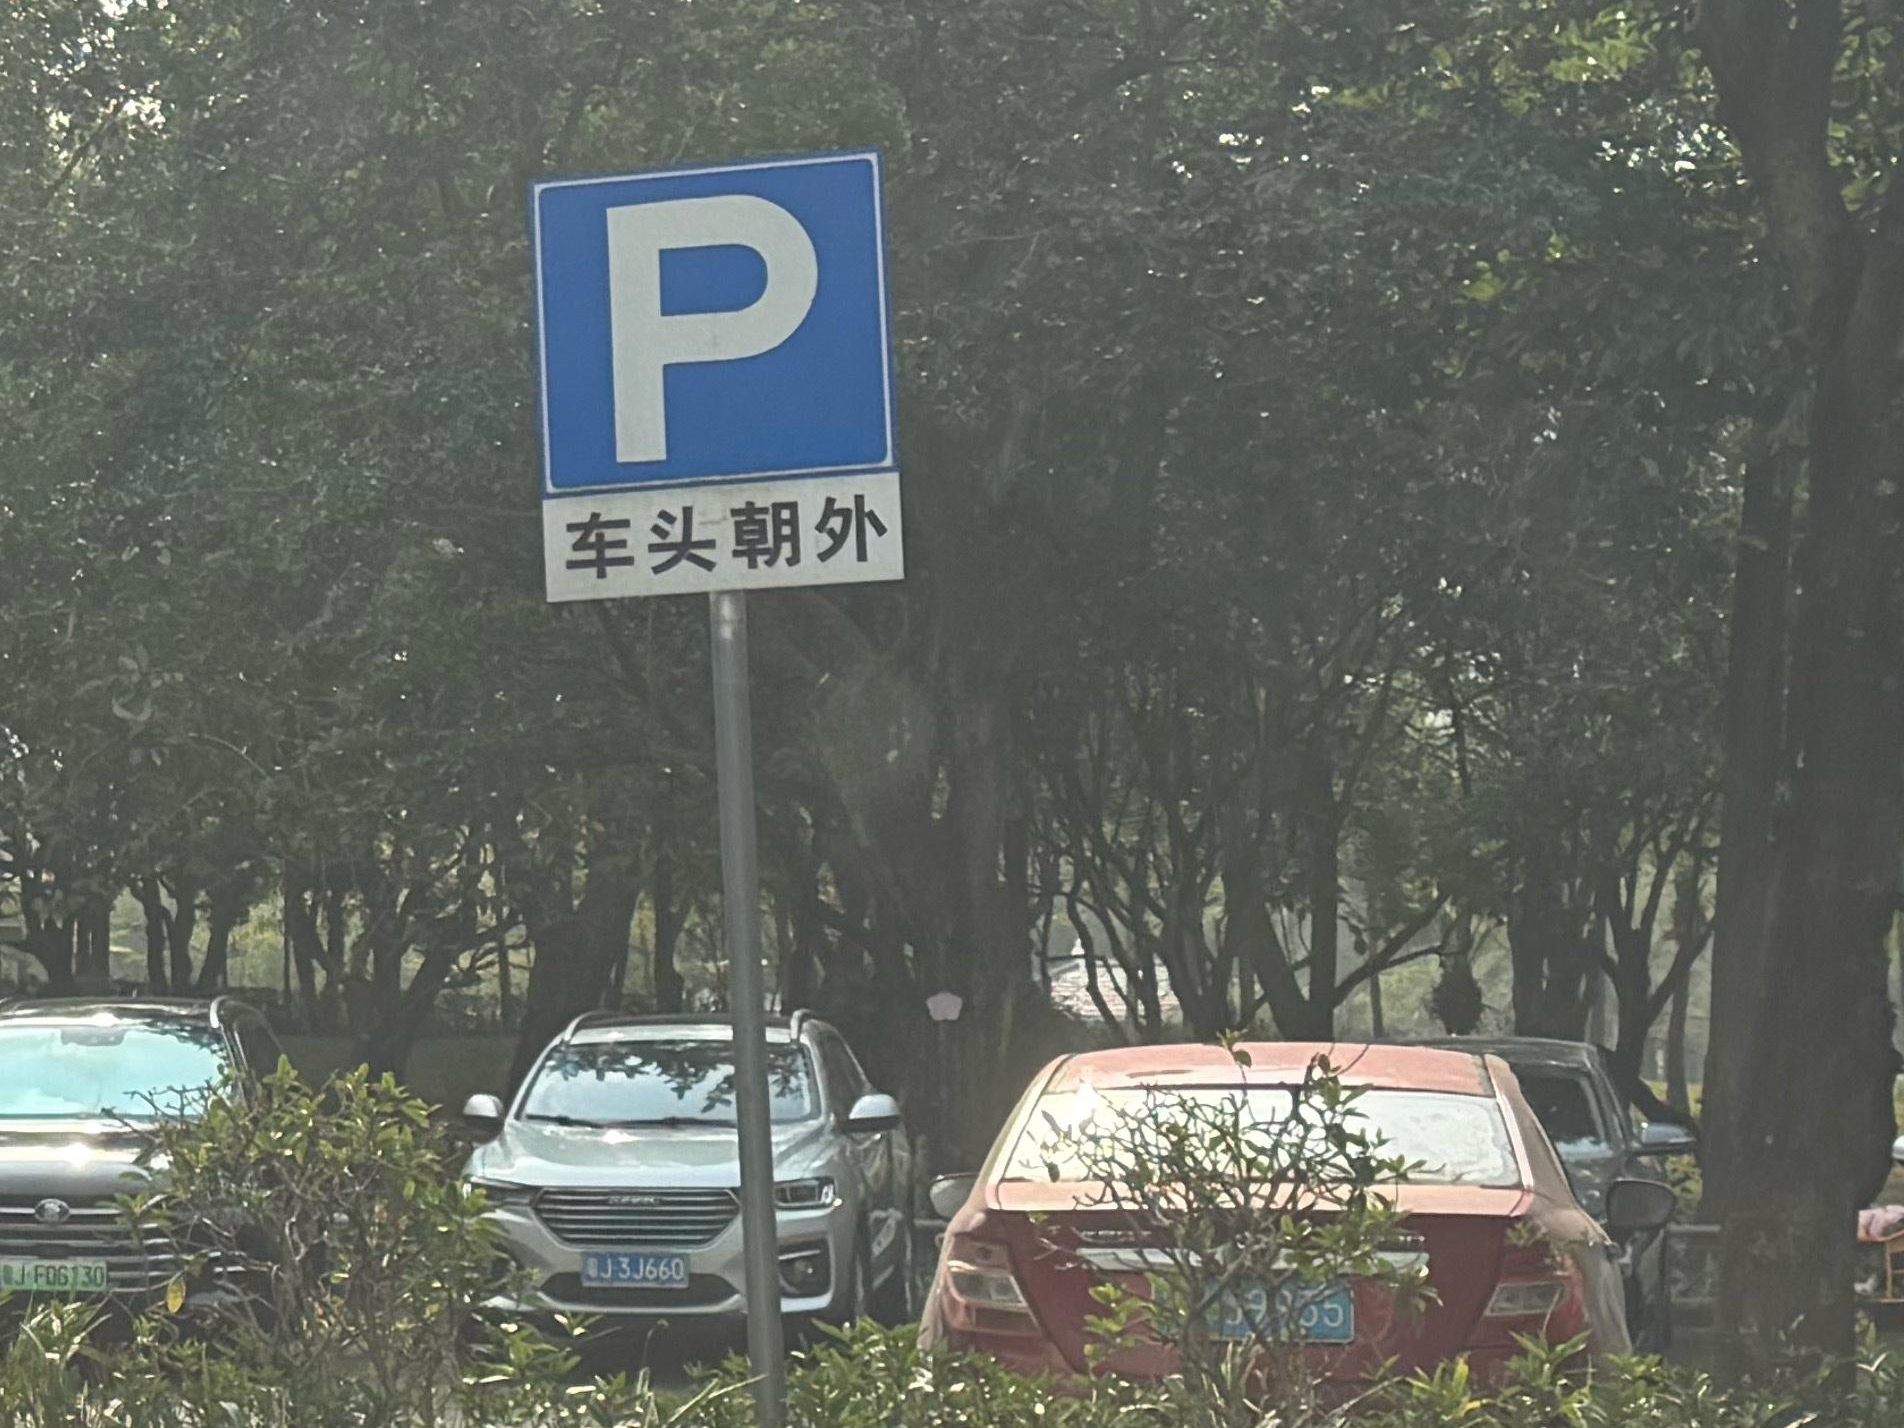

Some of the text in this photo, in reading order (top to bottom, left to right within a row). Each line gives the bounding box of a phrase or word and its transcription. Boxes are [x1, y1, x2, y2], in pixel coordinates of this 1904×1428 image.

[606, 194, 818, 463] P
[565, 494, 887, 579] 车头朝外
